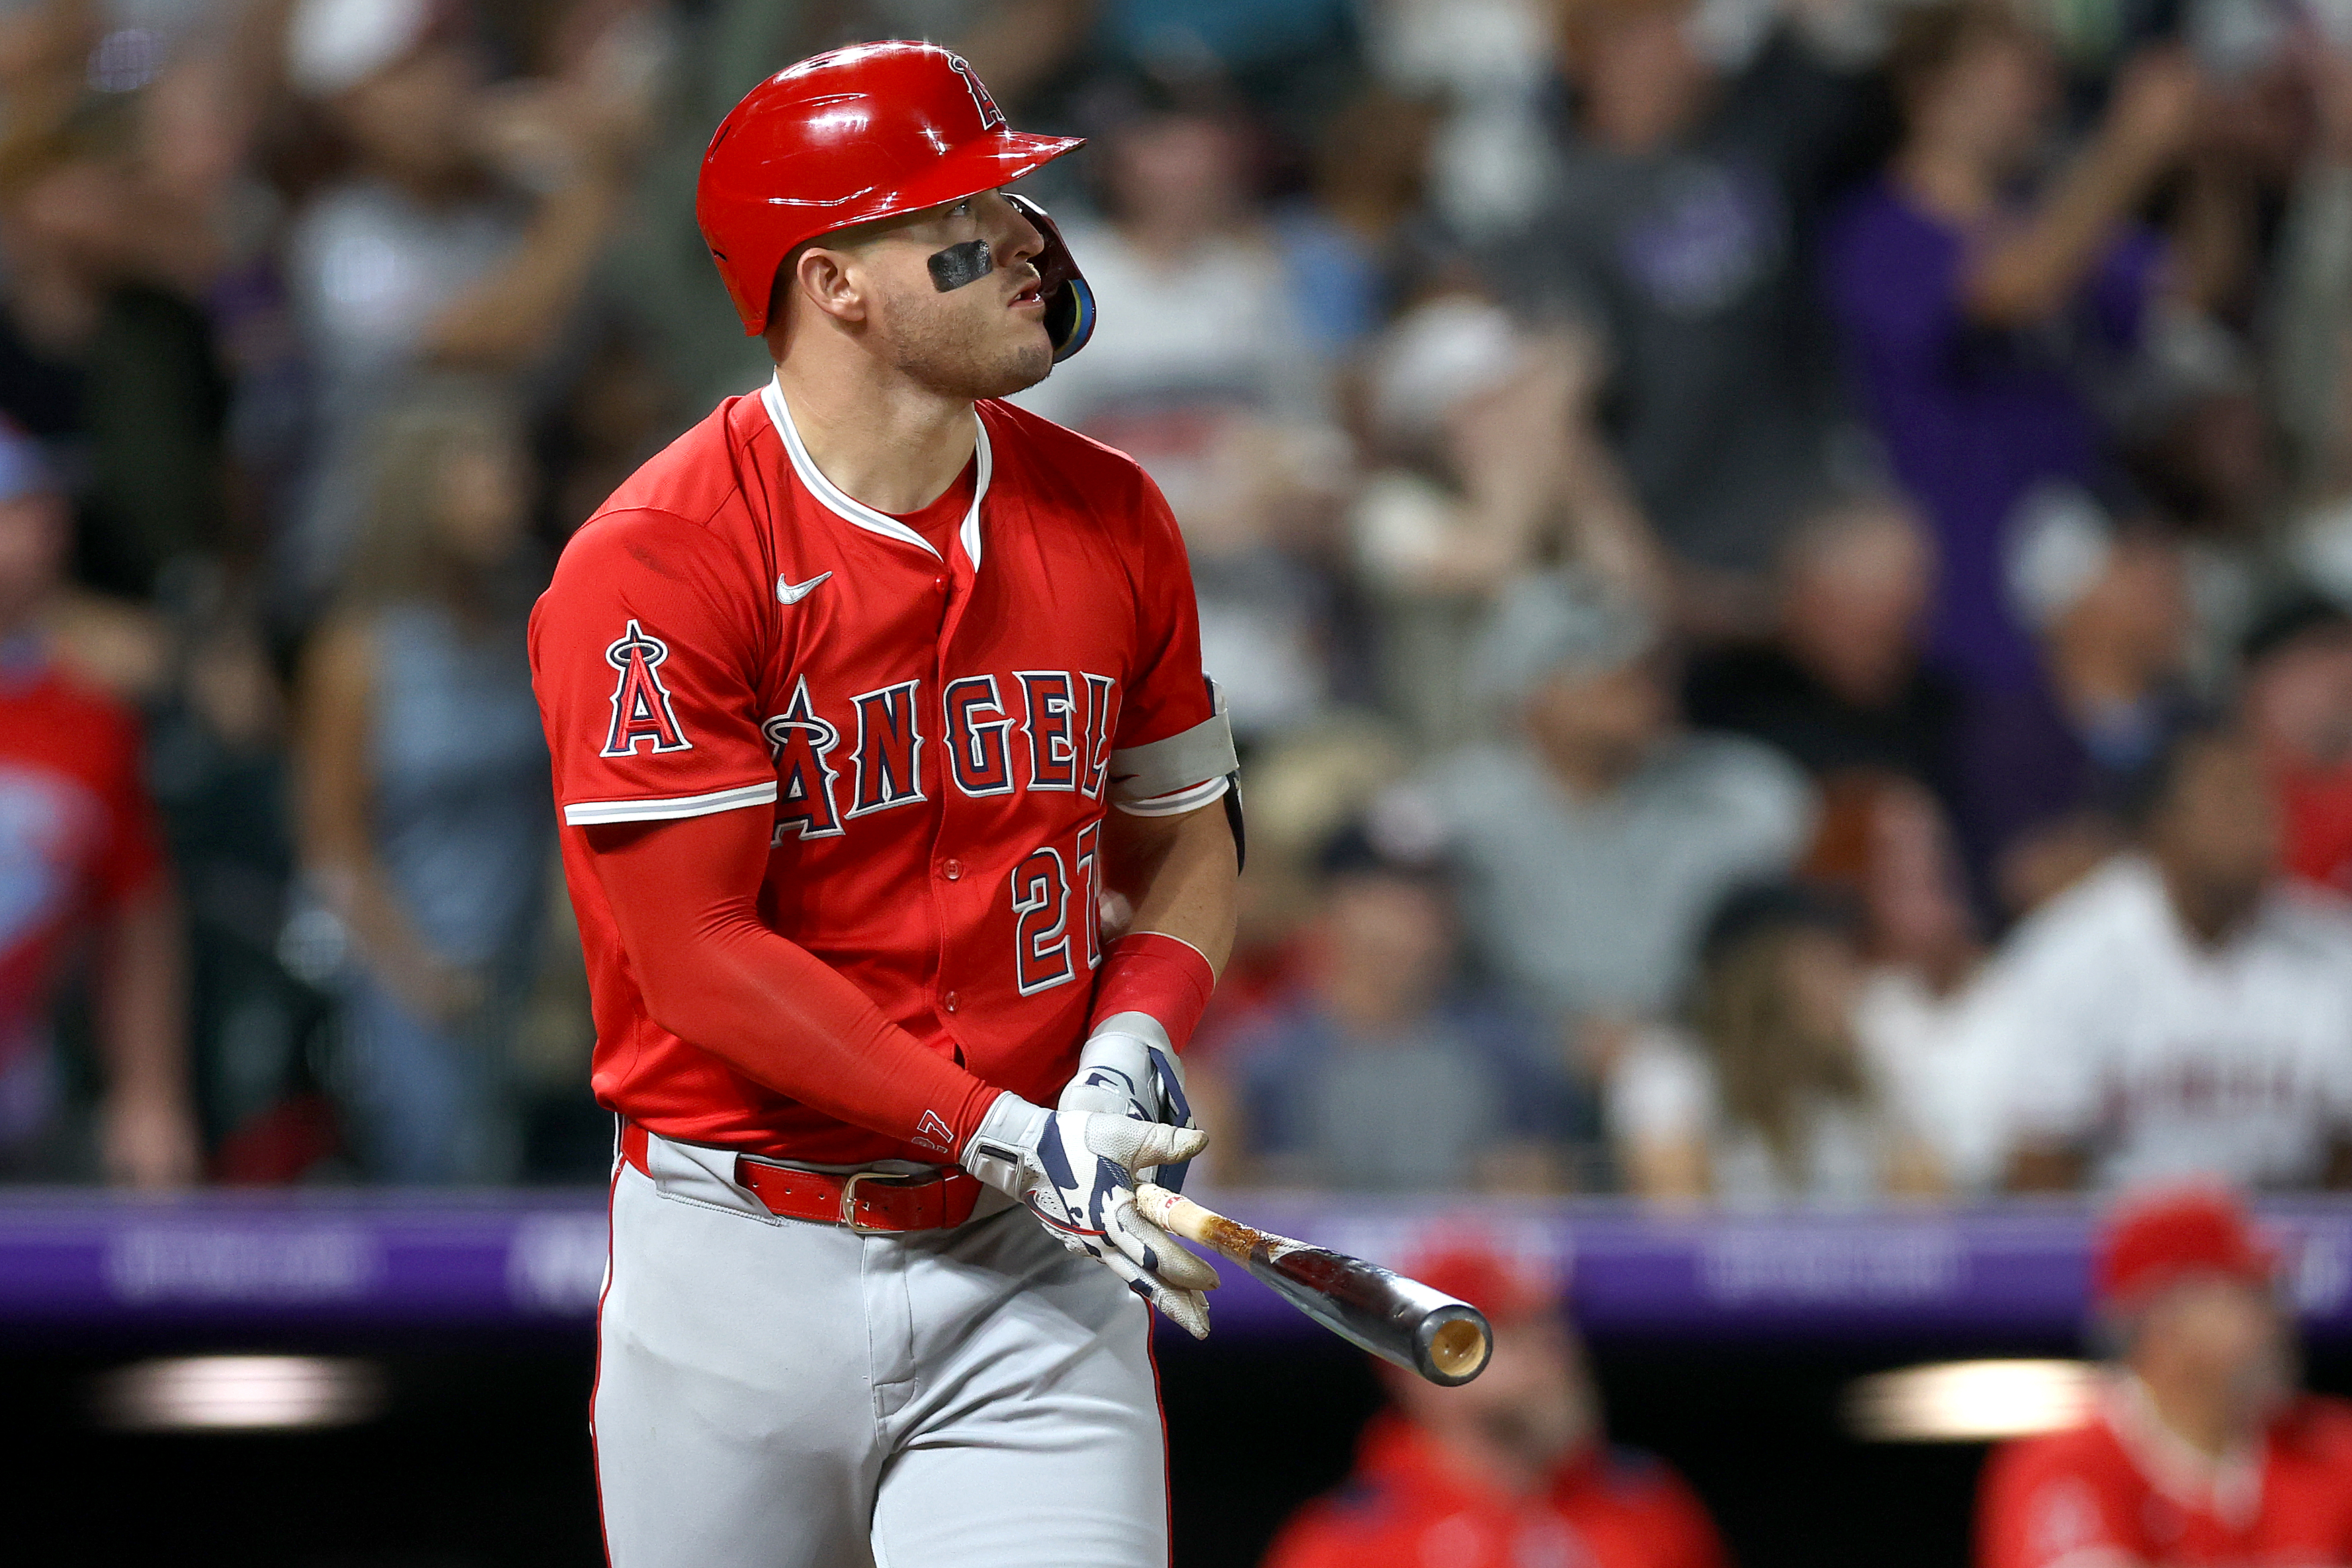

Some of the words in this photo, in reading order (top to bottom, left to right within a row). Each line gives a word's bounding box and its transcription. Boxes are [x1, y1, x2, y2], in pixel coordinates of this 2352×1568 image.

[944, 53, 1006, 130] A
[599, 619, 693, 758] A
[1010, 819, 1102, 997] 27
